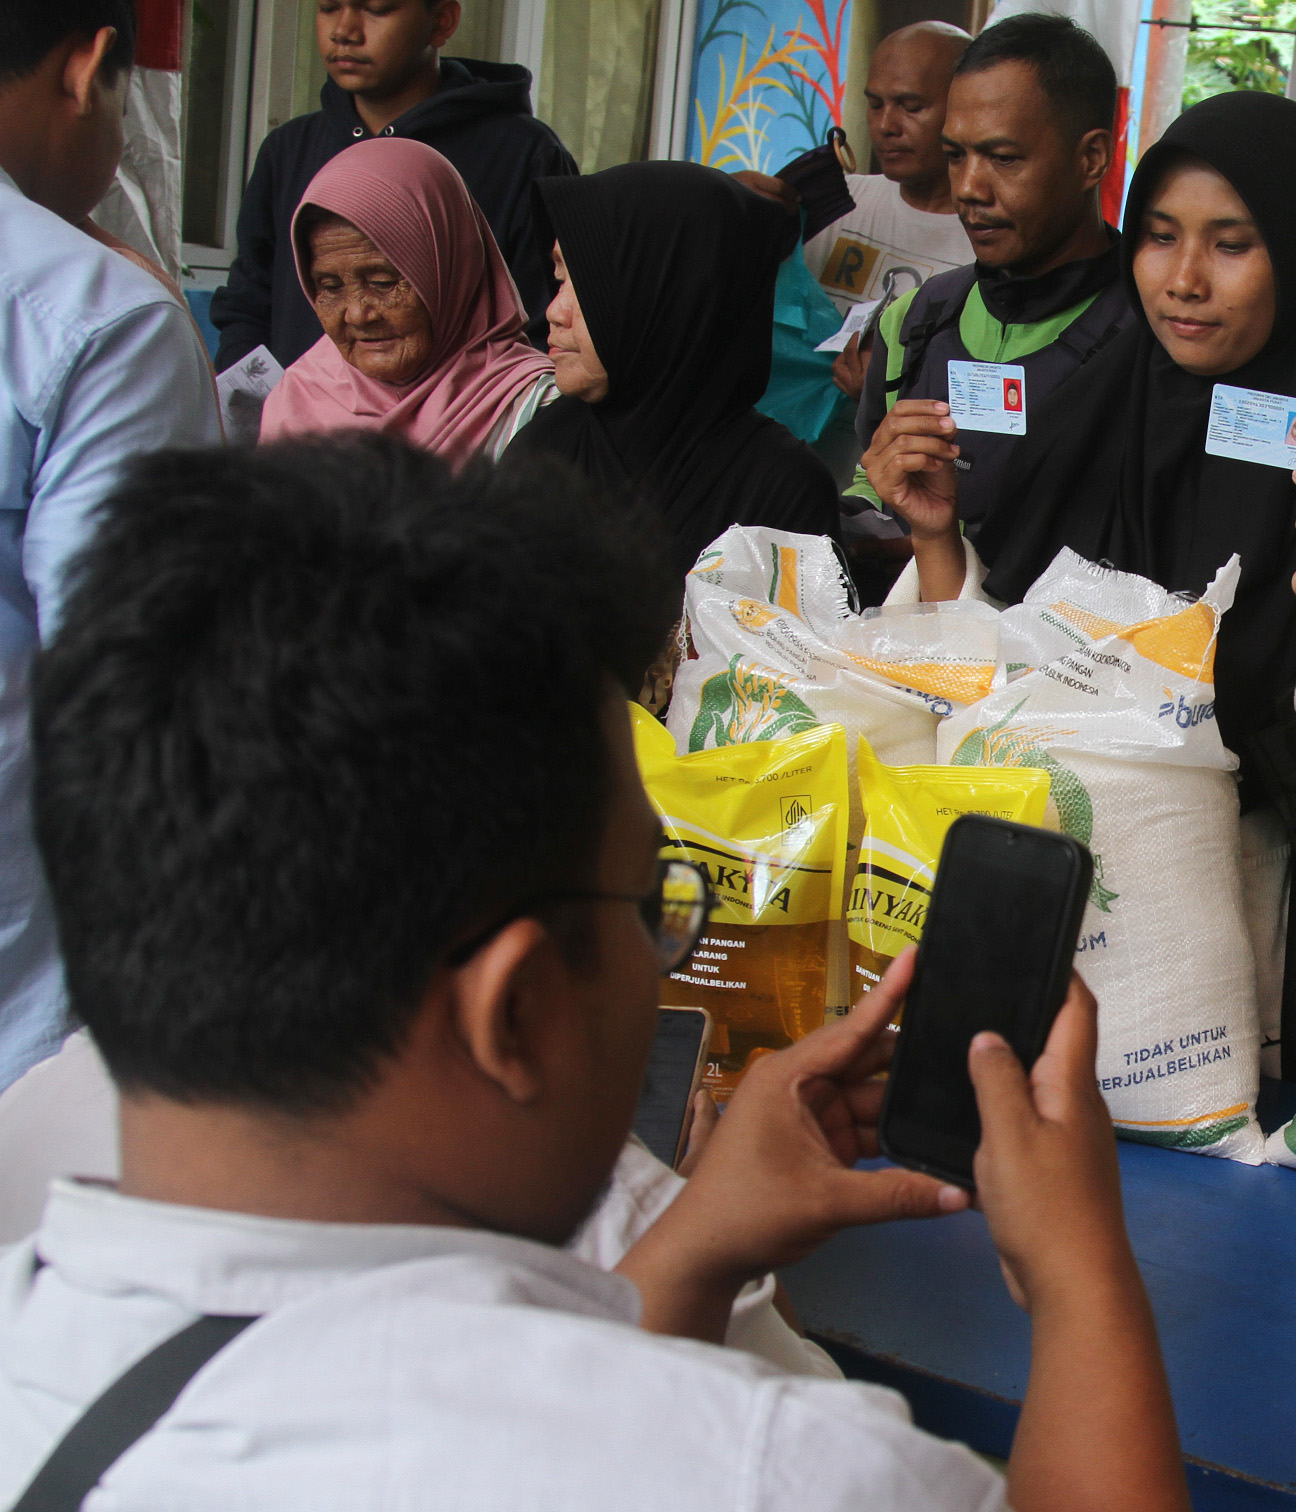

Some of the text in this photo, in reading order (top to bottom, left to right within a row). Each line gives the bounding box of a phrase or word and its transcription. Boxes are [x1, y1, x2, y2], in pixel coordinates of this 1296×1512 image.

[834, 245, 864, 288] R
[847, 887, 930, 932] INYAK
[865, 918, 891, 931] GORENG
[710, 938, 745, 948] PANGAN
[692, 951, 728, 961] LARANG
[692, 963, 719, 974] UNTUK
[856, 965, 880, 983] BANTUAN
[670, 972, 746, 989] DIPERJUALBELIKAN
[1124, 1025, 1228, 1066] TIDAK UNTUK
